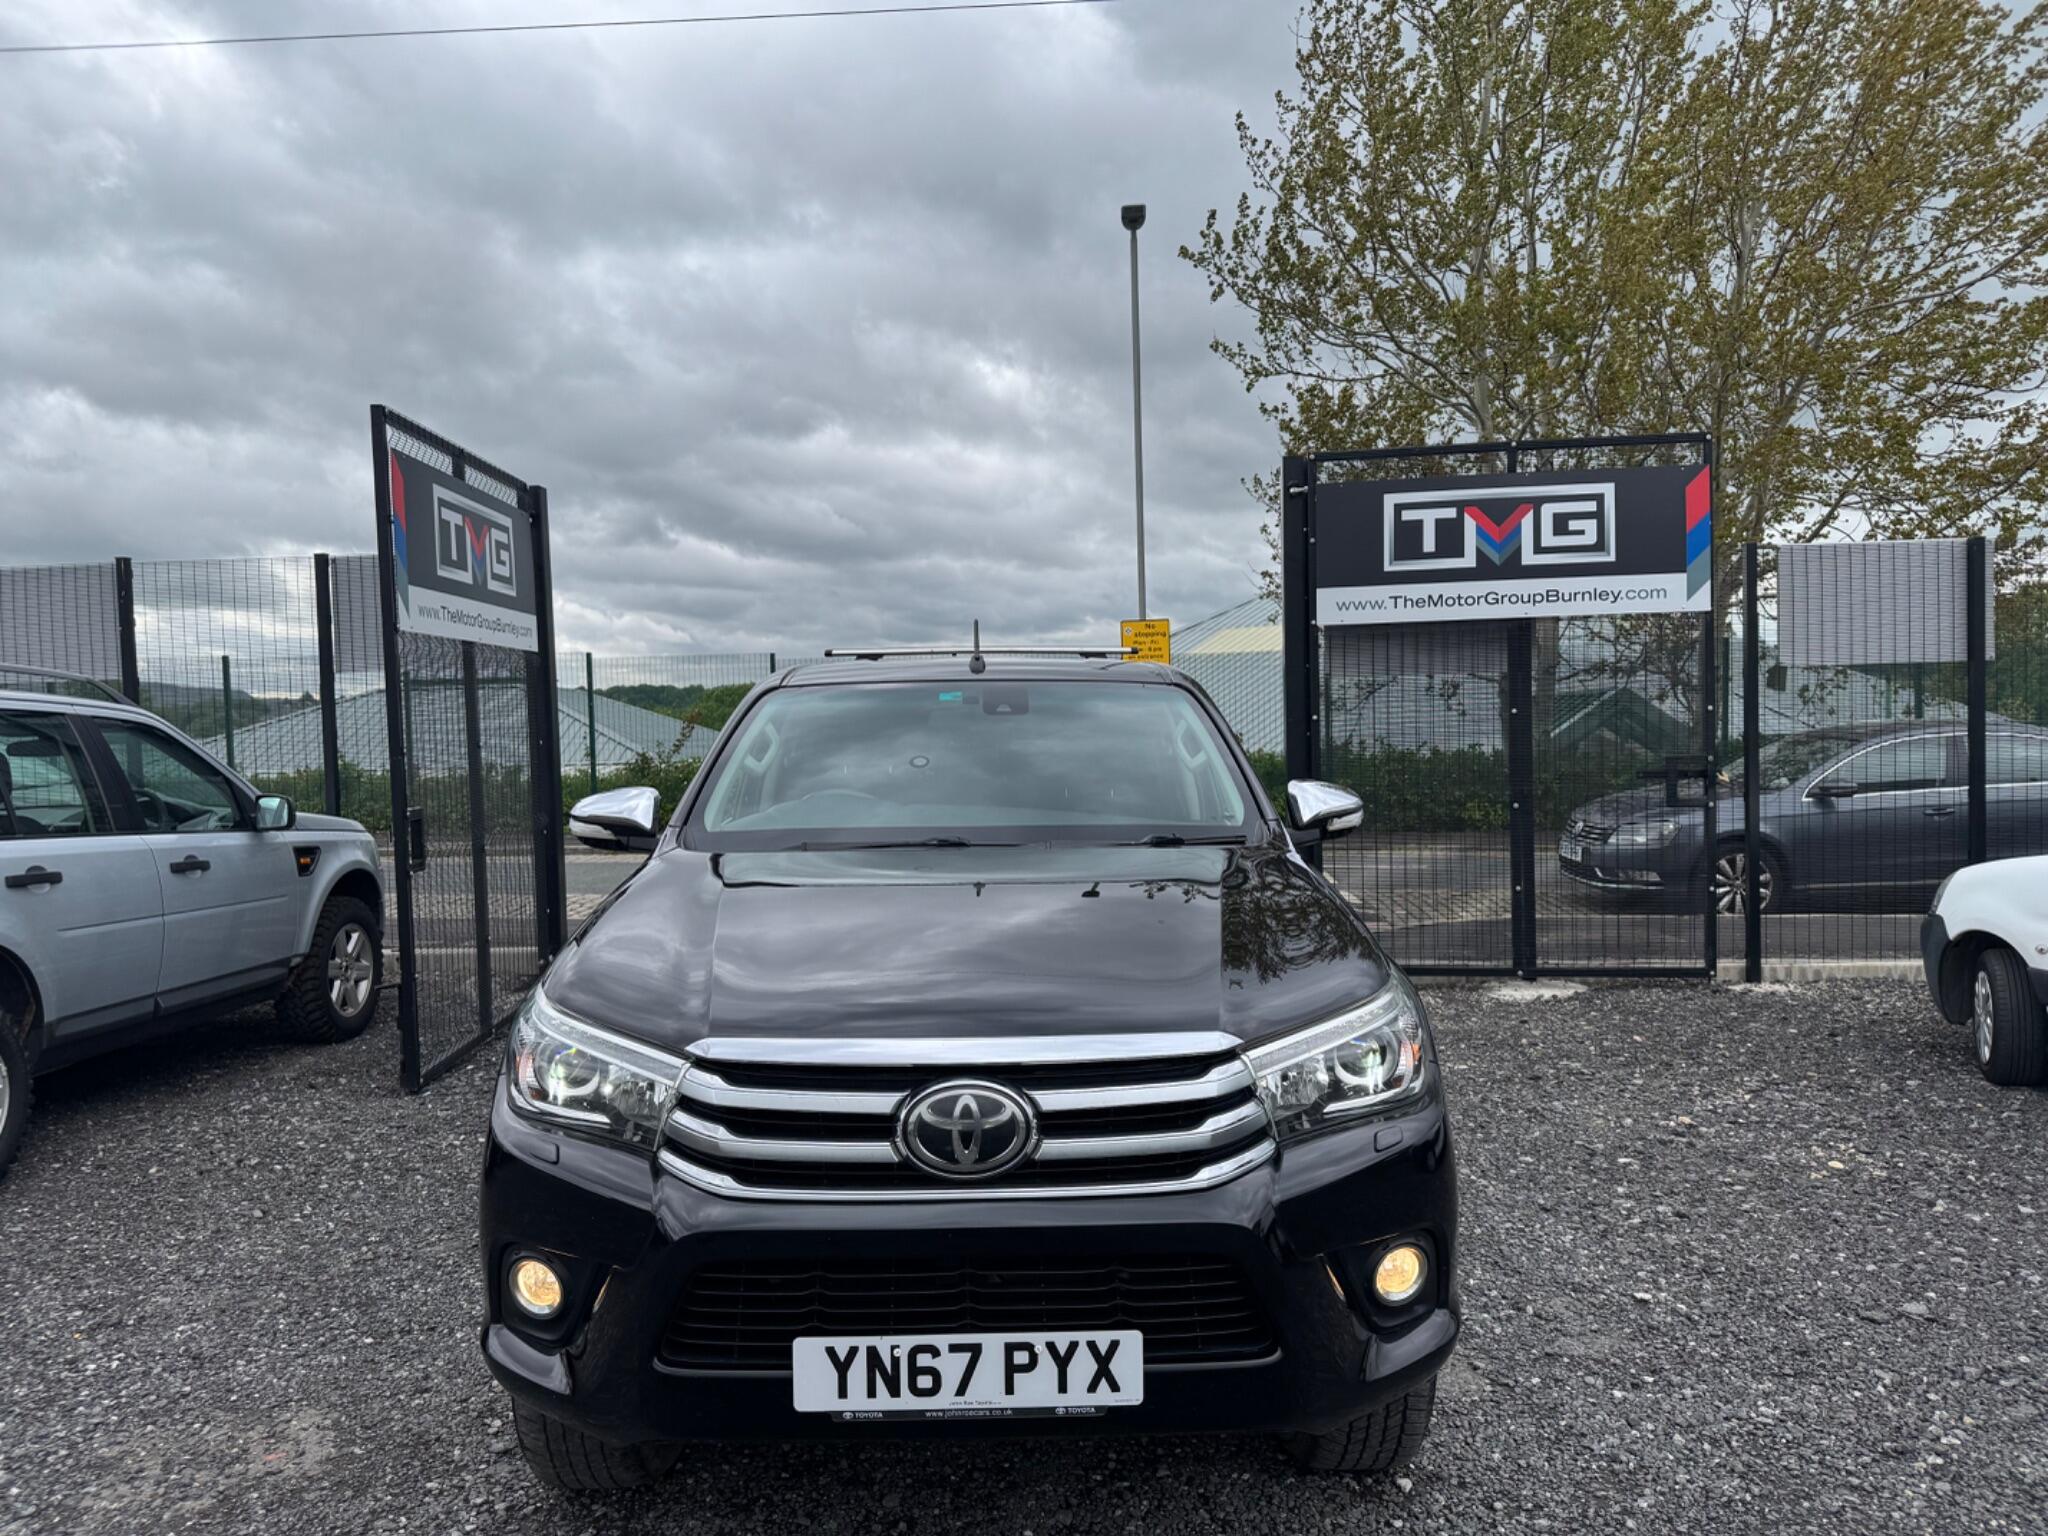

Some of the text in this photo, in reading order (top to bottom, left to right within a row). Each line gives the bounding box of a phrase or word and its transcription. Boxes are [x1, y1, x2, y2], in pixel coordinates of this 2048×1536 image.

[440, 506, 511, 587] TMG
[1400, 501, 1598, 567] TMG
[417, 604, 533, 639] www.TheMotorGroupBurnley.com
[1335, 587, 1667, 612] www.TheMotorGroupBurnley.com
[824, 1339, 1121, 1400] YN67 PYX
[855, 1411, 883, 1419] TOYOTA
